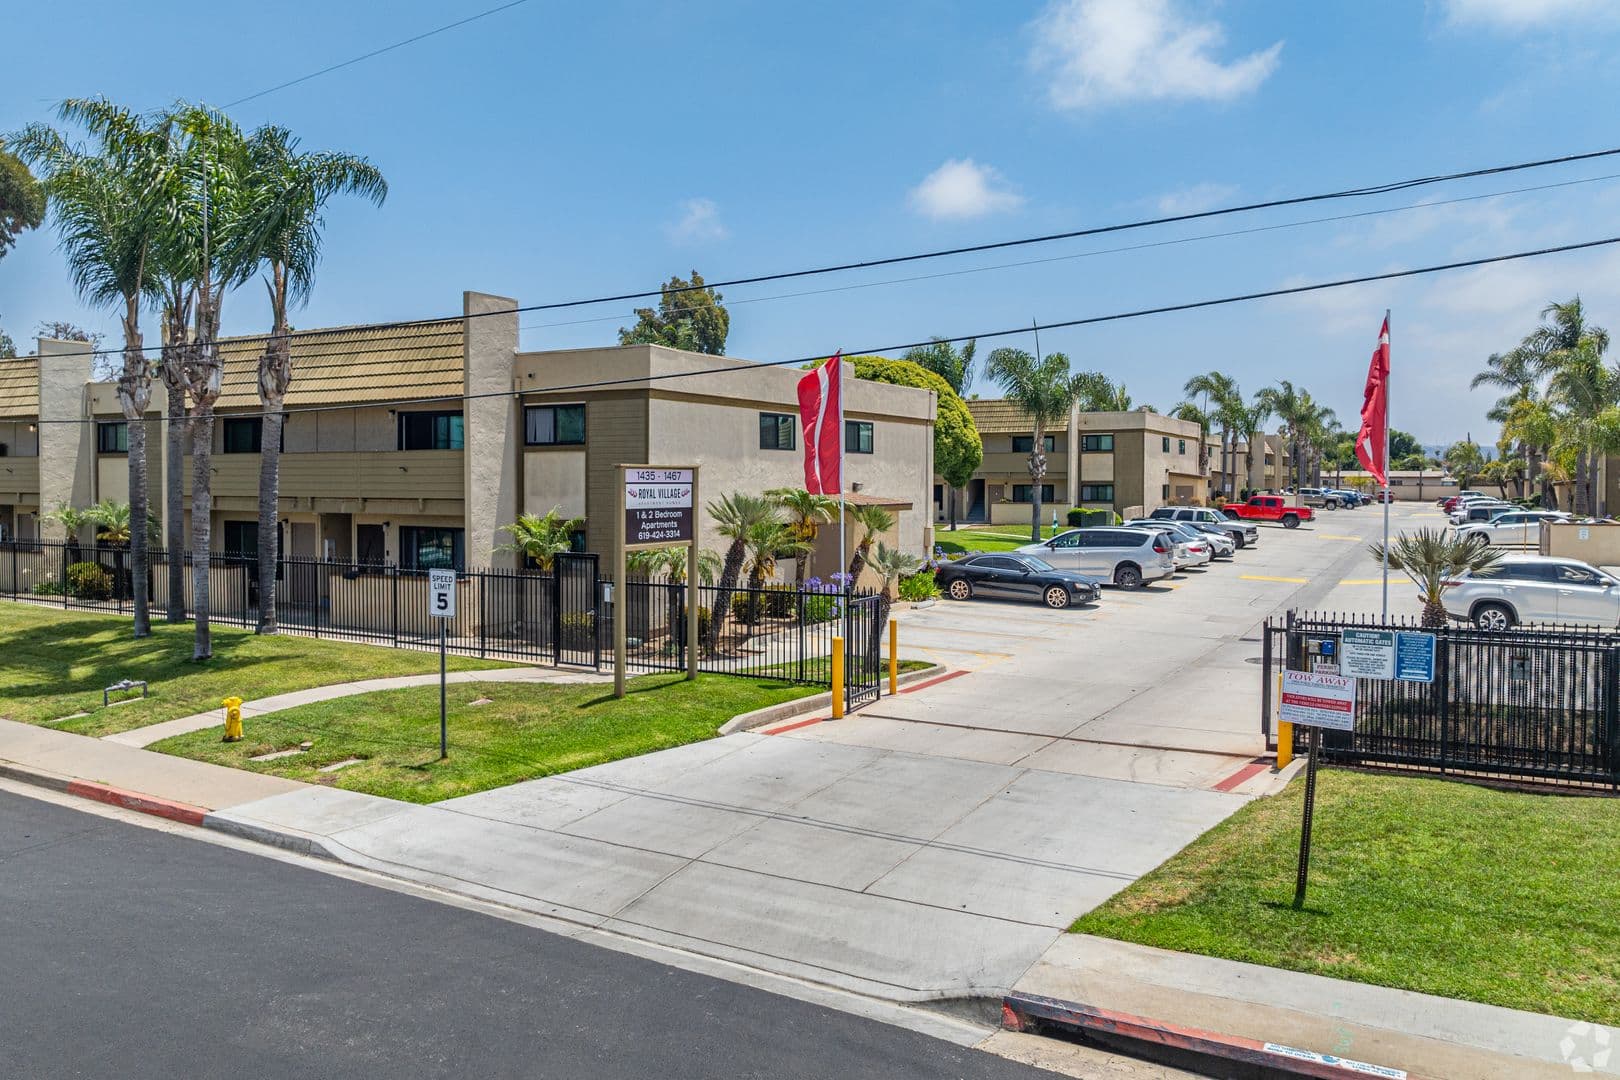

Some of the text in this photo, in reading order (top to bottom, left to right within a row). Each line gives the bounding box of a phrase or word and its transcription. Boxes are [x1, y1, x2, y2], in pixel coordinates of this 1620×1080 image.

[637, 471, 656, 480] 1435
[664, 471, 682, 480] 1467
[638, 488, 681, 499] ROYAL VILLAGE
[641, 520, 678, 530] Apartments
[638, 530, 680, 540] 619-424-3314
[432, 574, 453, 583] SPEED
[437, 593, 448, 610] 5
[1288, 673, 1313, 682] TOW
[1316, 677, 1349, 686] AWAY
